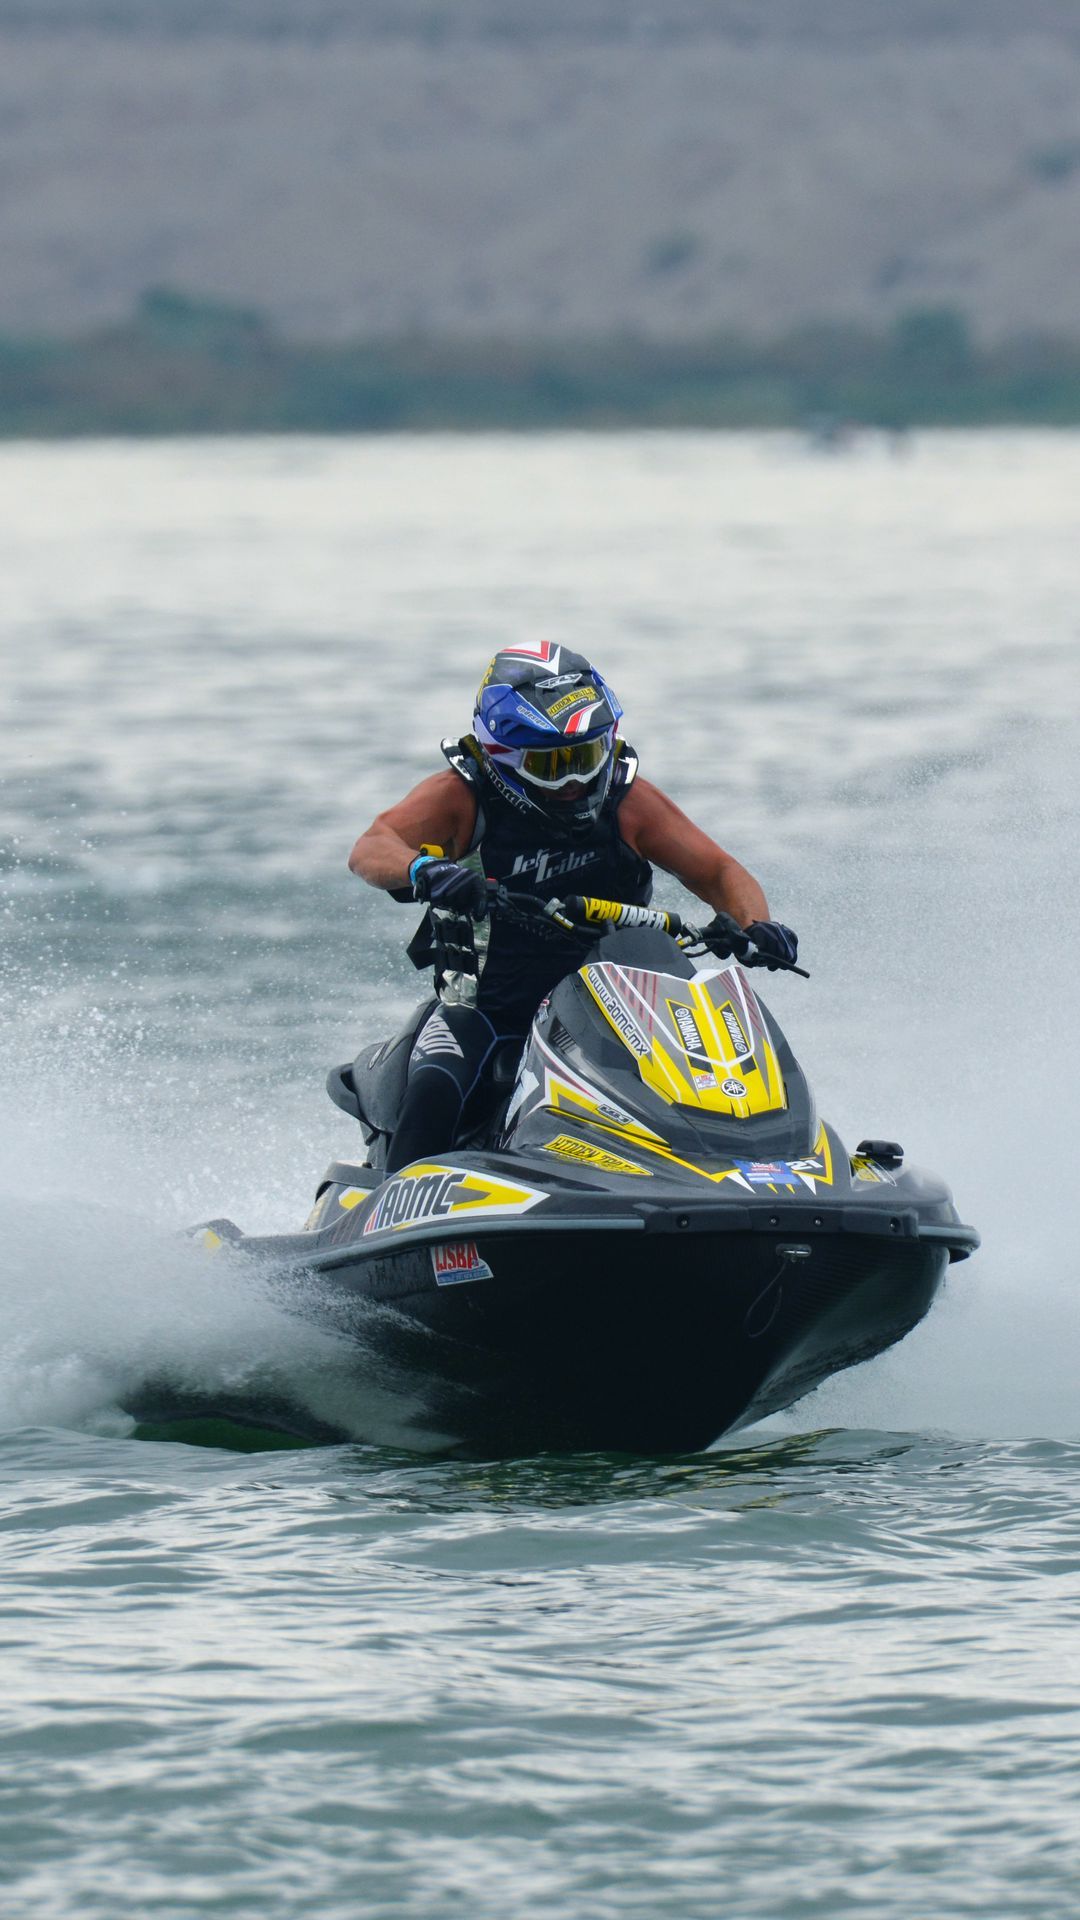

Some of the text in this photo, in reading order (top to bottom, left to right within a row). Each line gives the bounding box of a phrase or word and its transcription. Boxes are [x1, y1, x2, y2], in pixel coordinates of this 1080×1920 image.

[548, 697, 572, 716] HIDDEN
[589, 968, 649, 1057] www.aomc.mx
[722, 1011, 746, 1045] YAMAHA
[677, 1014, 703, 1051] YAMAHA
[551, 1138, 600, 1158] HIDDEN
[376, 1173, 467, 1229] AOMC
